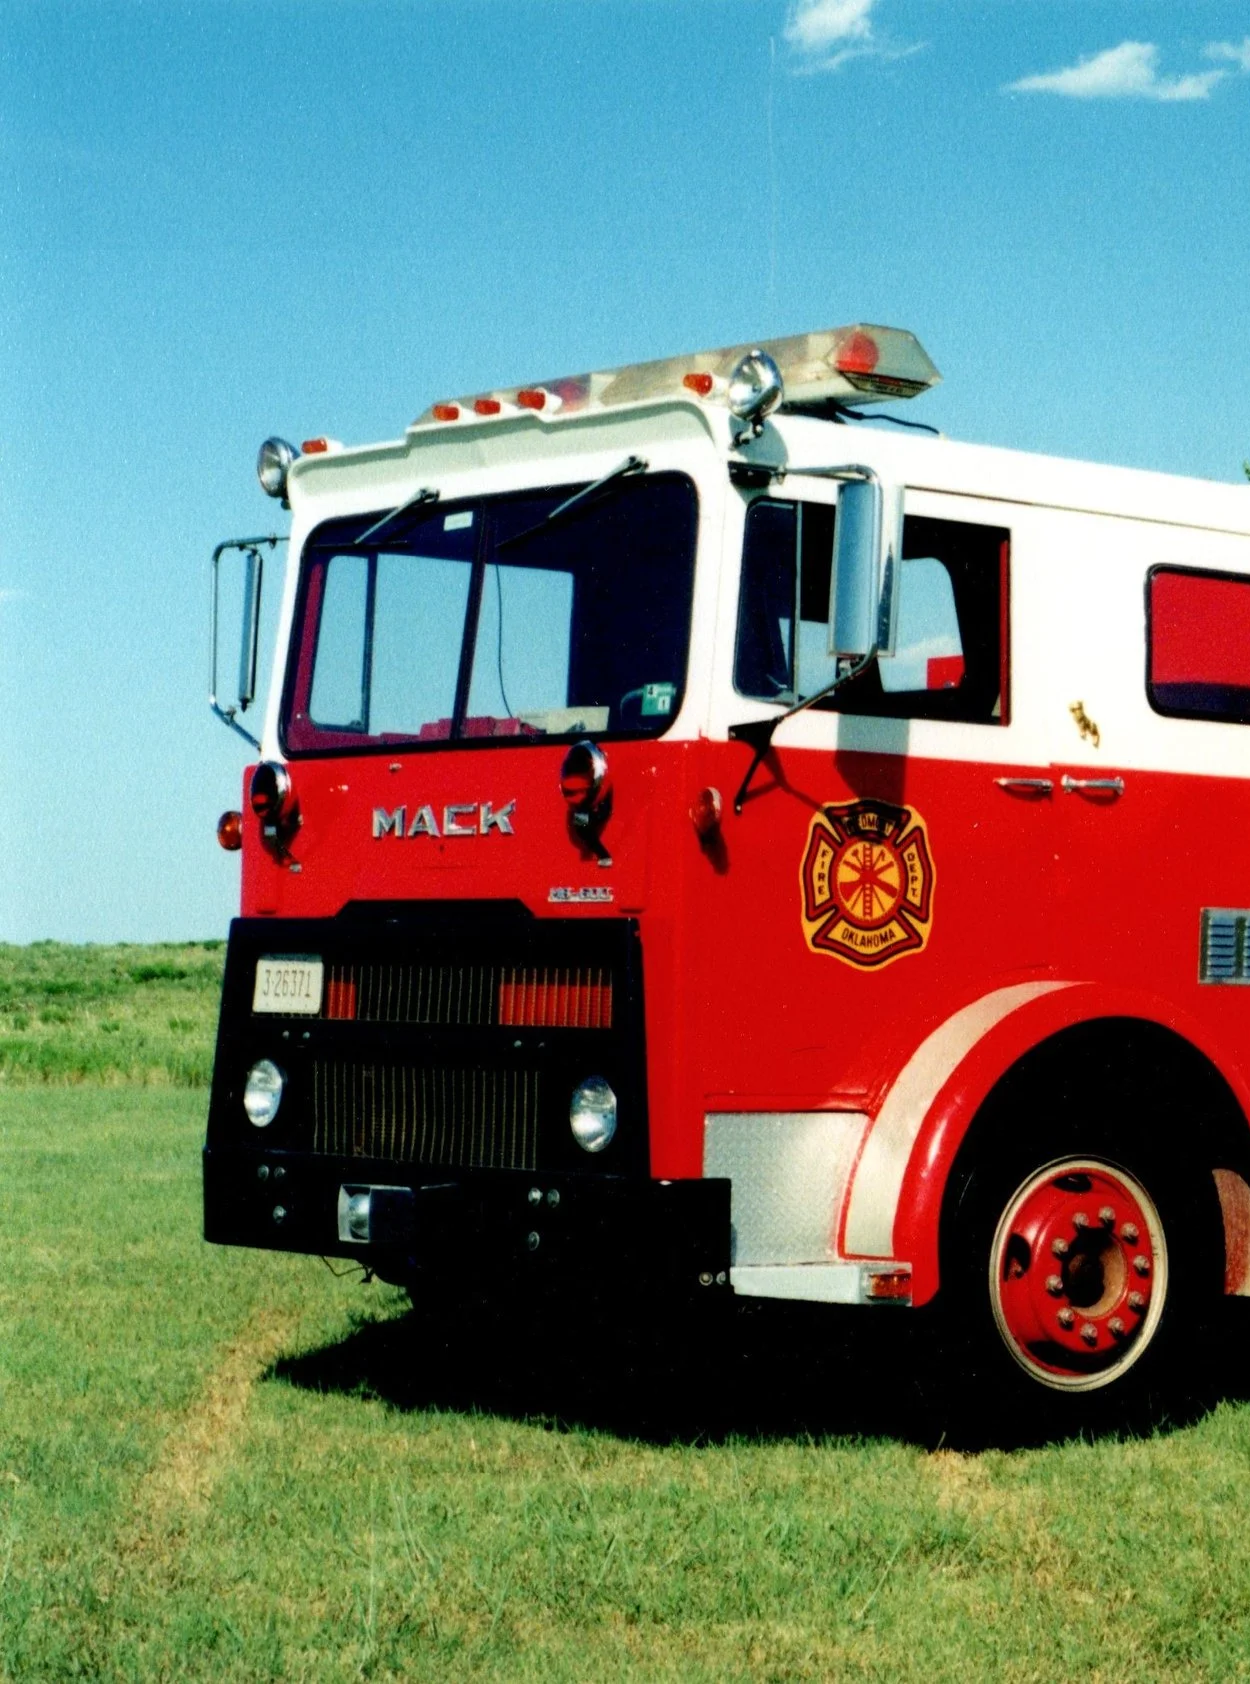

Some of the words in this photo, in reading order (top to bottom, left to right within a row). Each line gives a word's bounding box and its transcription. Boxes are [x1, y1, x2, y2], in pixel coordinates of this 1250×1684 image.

[371, 799, 516, 838] MACK
[817, 848, 829, 895] FIRE
[841, 928, 896, 948] OKLAHOMA
